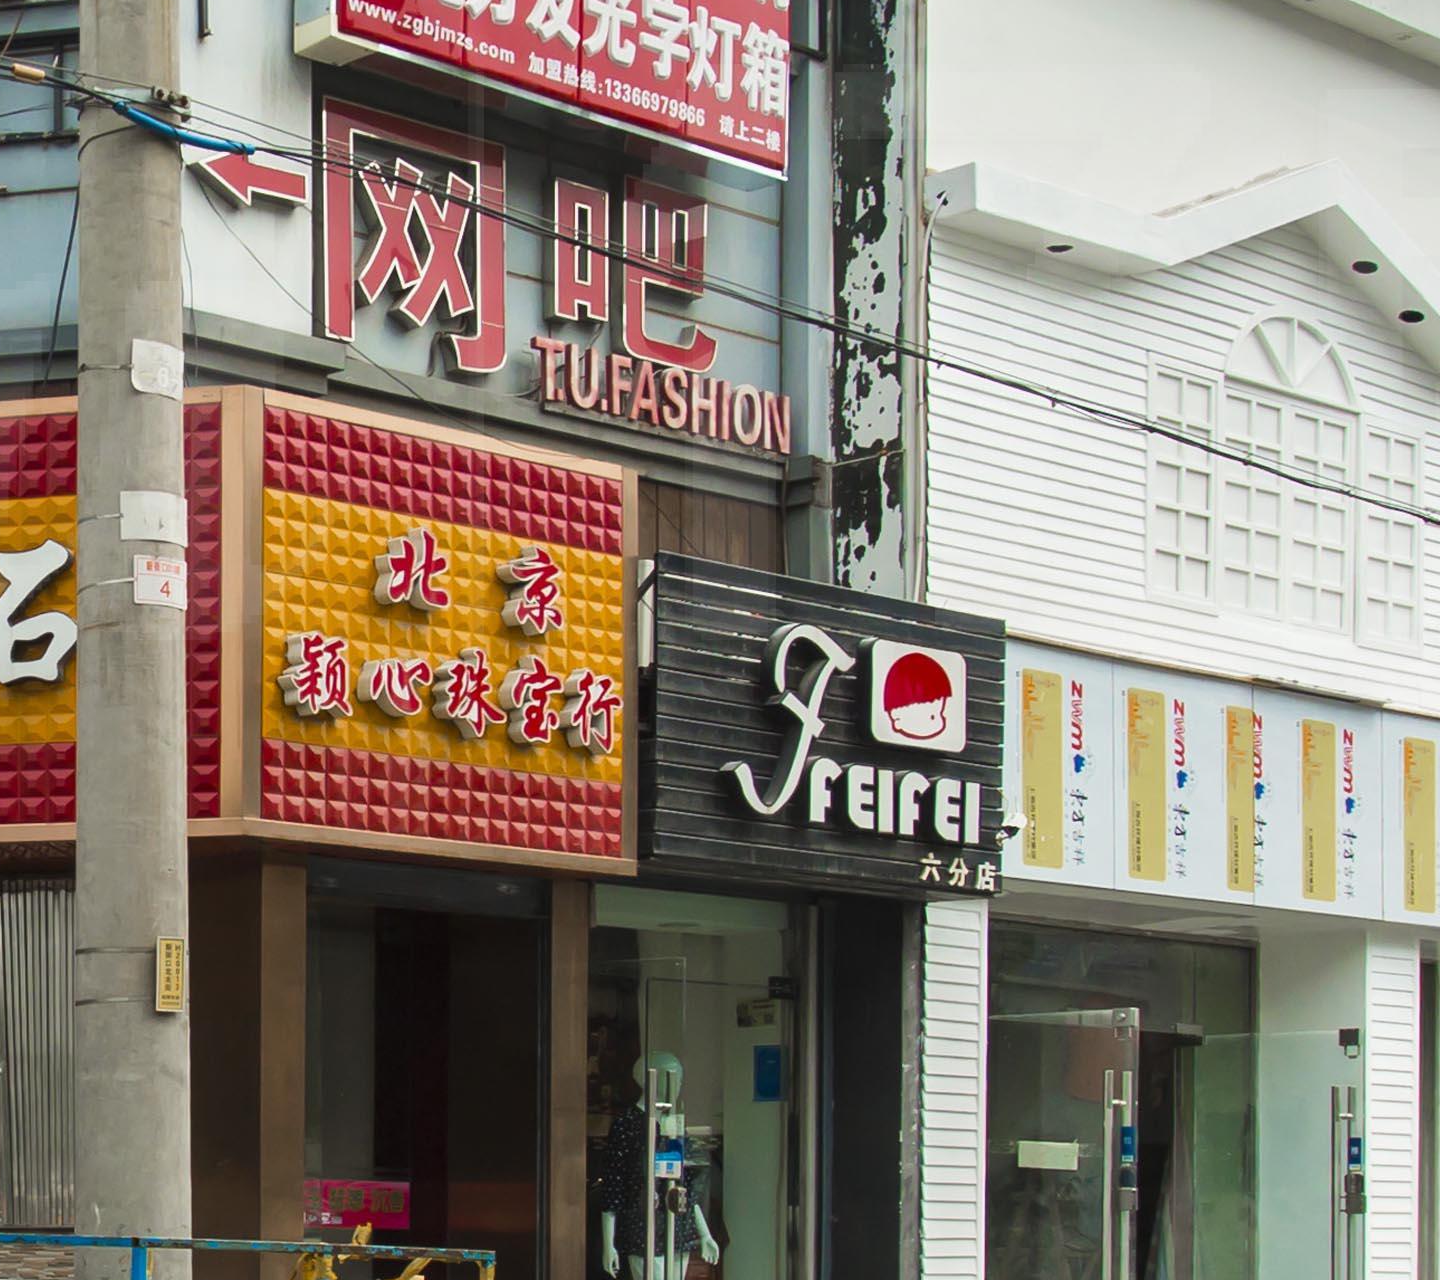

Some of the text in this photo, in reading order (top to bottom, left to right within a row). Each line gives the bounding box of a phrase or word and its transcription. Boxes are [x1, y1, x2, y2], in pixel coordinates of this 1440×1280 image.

[718, 113, 782, 153] 请上二楼
[322, 95, 717, 374] 网吧
[376, 527, 566, 637] 北京
[278, 631, 624, 756] 颖心珠宝行
[919, 852, 997, 892] 六分店
